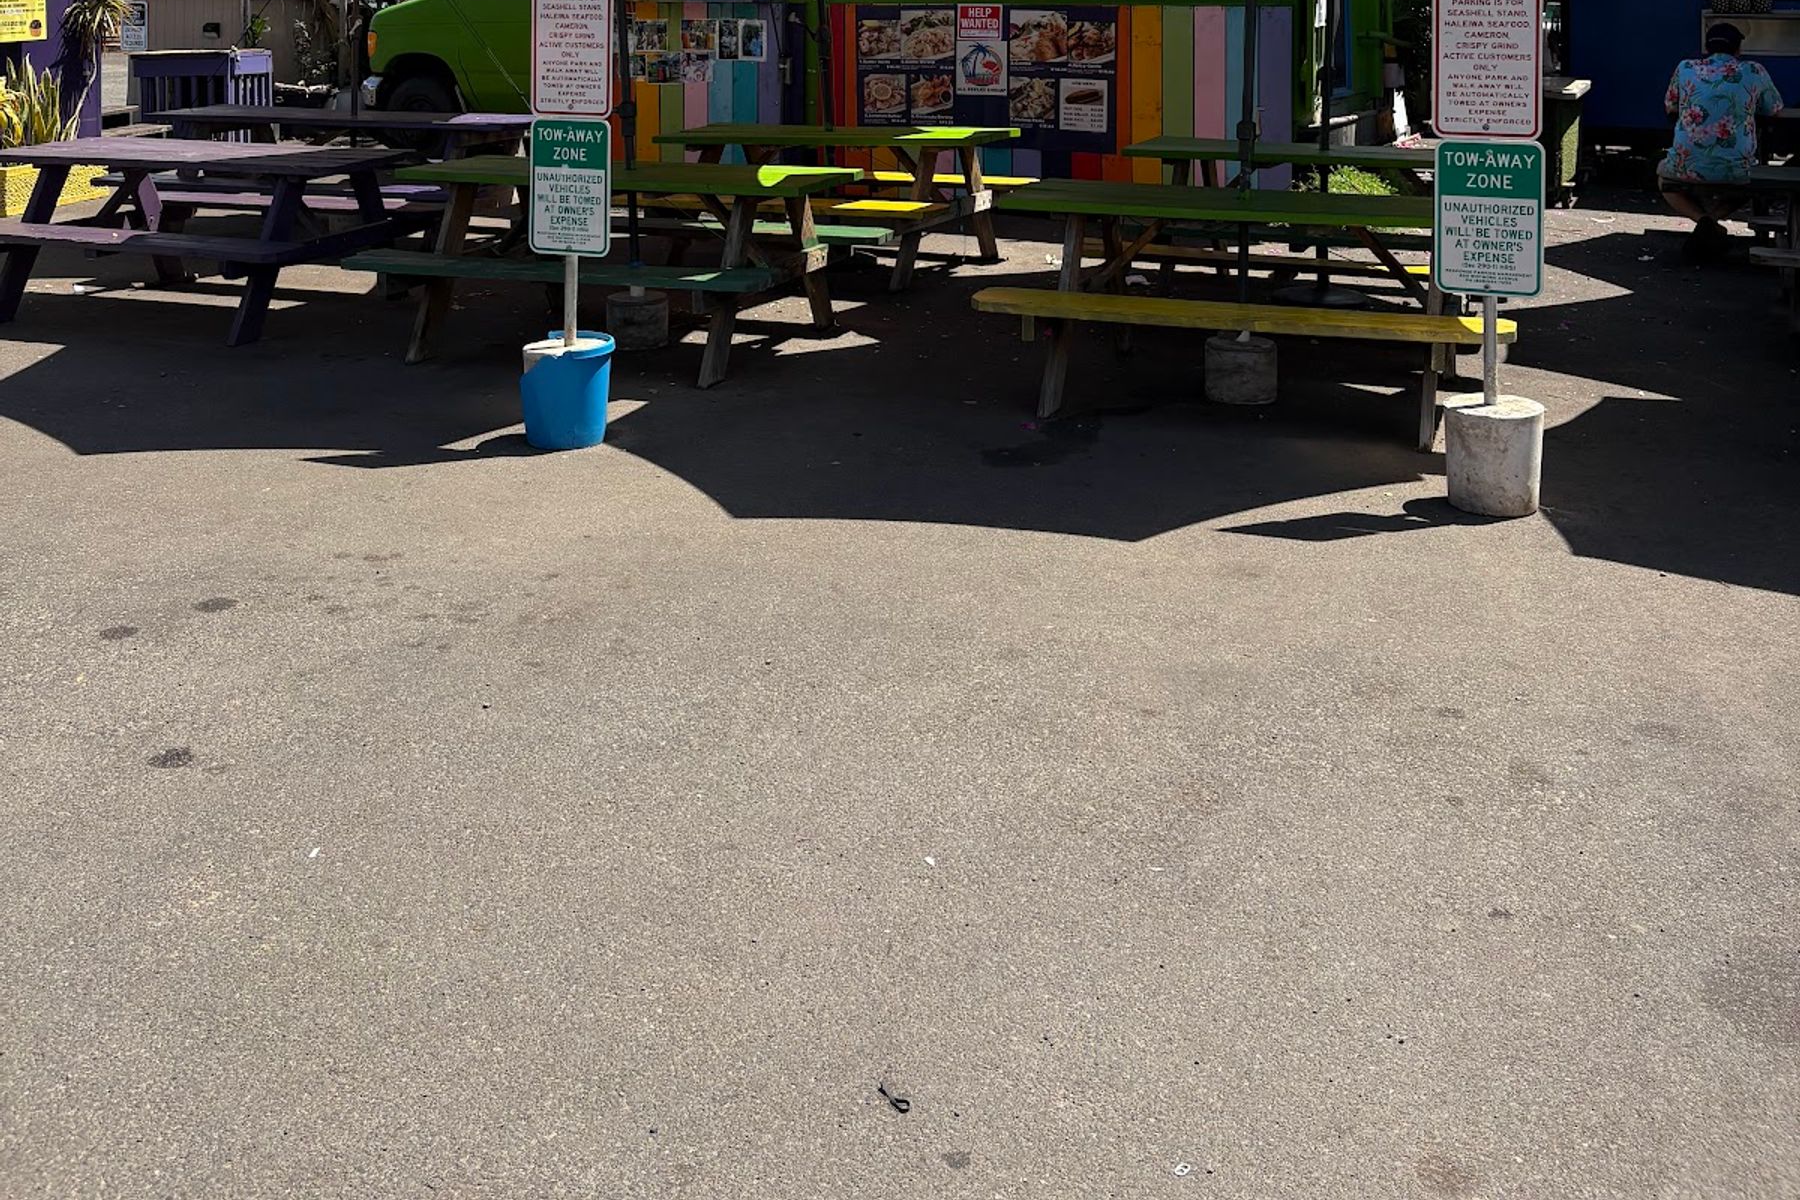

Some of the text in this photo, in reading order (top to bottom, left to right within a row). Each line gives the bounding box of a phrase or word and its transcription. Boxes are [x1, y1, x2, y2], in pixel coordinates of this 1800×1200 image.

[968, 7, 992, 18] HELP
[1447, 9, 1493, 17] SEASHELL
[961, 18, 999, 29] WANTED
[1444, 20, 1484, 28] HALEIWA
[1443, 52, 1532, 61] ACTIVE CUSTOMERS
[1473, 63, 1498, 71] ONLY
[1459, 91, 1530, 99] AUTOMATICALLY
[1444, 116, 1483, 124] STRICTLY
[537, 127, 603, 143] TOW-AWAY
[553, 147, 588, 161] ZONE
[1444, 151, 1535, 169] TOW-AWAY
[537, 173, 603, 184] UNAUTHORIZED
[1466, 172, 1513, 190] ZONE
[549, 184, 591, 194] VEHICLES
[537, 193, 602, 206] WILL BE TOWED
[544, 204, 595, 216] AT OWNER'S
[1444, 202, 1535, 216] UNAUTHORIZED
[550, 216, 588, 226] EXPENSE
[1460, 214, 1518, 227] VEHICLES
[1445, 225, 1533, 240] WILL BE TOWED
[1455, 238, 1524, 252] AT OWNER'S
[1463, 250, 1515, 264] EXPENSE
